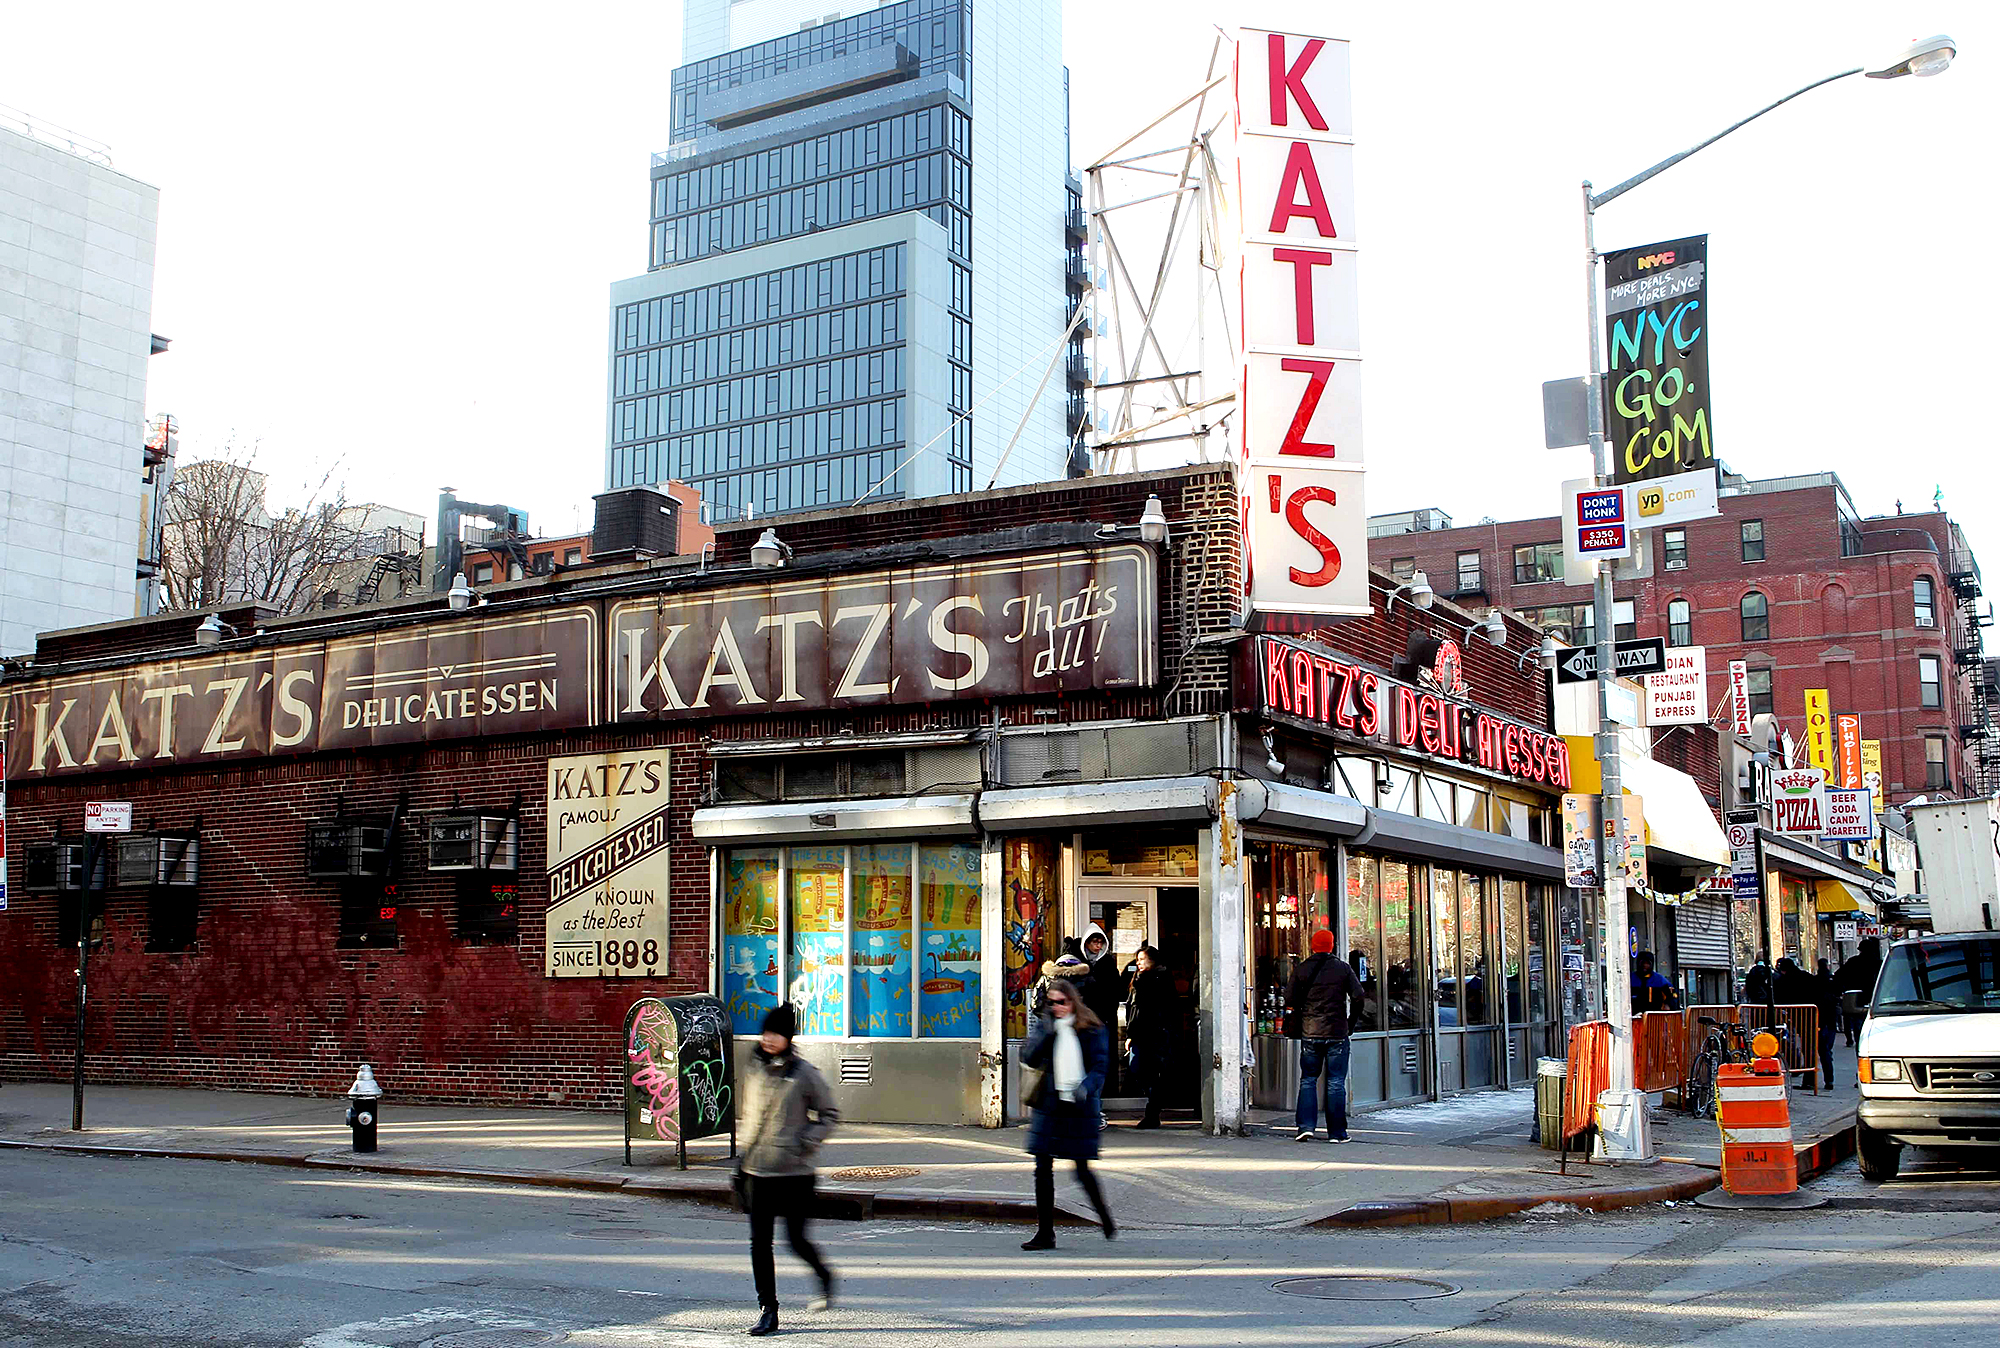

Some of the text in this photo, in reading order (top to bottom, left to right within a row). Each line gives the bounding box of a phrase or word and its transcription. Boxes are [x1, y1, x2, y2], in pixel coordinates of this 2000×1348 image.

[1637, 251, 1676, 270] NYC
[1611, 273, 1674, 301] MORE DEALS.
[1636, 276, 1697, 306] MORE NYC.
[1268, 34, 1342, 588] KATZ'S
[1610, 299, 1701, 371] NYC
[1614, 367, 1695, 423] GO.
[1583, 497, 1616, 508] DON'T
[1584, 508, 1616, 518] HONK
[1584, 537, 1619, 547] PENALTY
[1589, 530, 1614, 539] $350
[620, 579, 1117, 713] KATZ'S That's
[1617, 650, 1649, 666] WAY
[1267, 640, 1378, 736] KATZ'S
[1651, 673, 1699, 687] RESTAURANT
[1654, 691, 1696, 702] PUNJABI
[1733, 672, 1749, 734] PIZZA
[28, 669, 559, 772] KATZ'S DELICATESSEN
[1655, 706, 1696, 717] EXPRESS
[553, 759, 662, 800] KATZ'S
[1832, 794, 1856, 802] BEER
[88, 804, 129, 816] NO PARKING
[1775, 798, 1822, 831] PIZZA
[1832, 805, 1857, 813] SODA
[1830, 816, 1860, 824] CANDY
[559, 808, 620, 852] FAMOUS
[1569, 841, 1591, 851] GAWD!
[550, 815, 664, 901] DELICATESSEN
[595, 887, 654, 905] KNOWN
[563, 908, 645, 931] as the Best
[553, 951, 593, 967] SINCE
